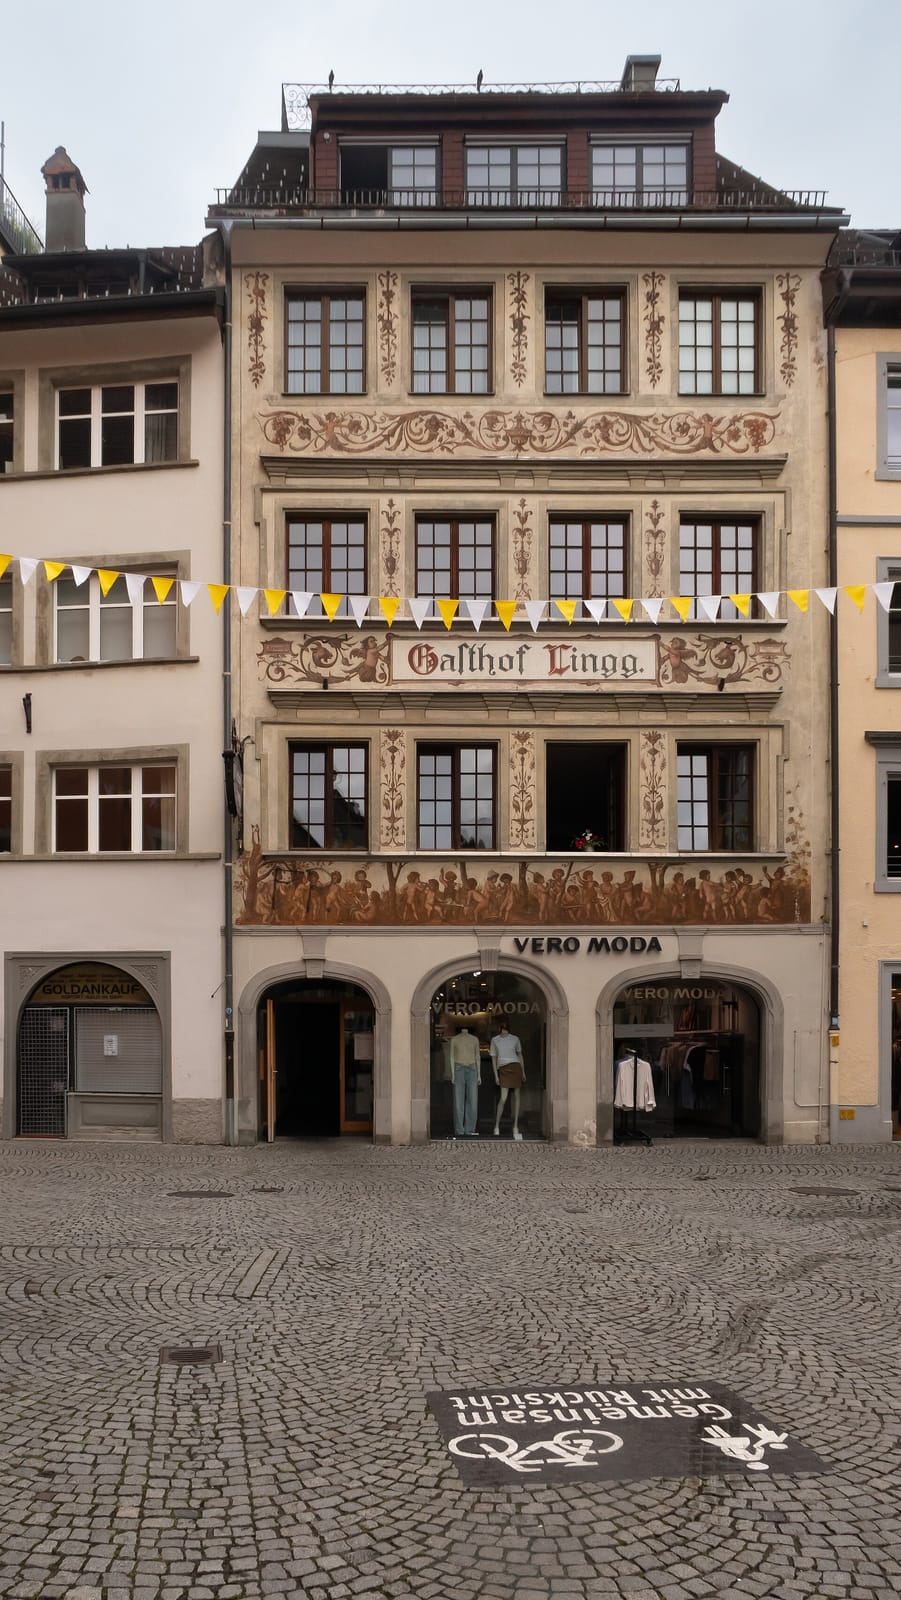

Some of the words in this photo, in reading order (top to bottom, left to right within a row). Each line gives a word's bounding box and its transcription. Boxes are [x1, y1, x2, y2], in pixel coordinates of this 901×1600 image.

[513, 936, 581, 954] VERO
[587, 936, 662, 954] MODA
[42, 984, 142, 995] GOLDANKAUF
[623, 987, 669, 1001] VERO
[673, 987, 725, 1001] MODA
[431, 1001, 482, 1015] VERO
[487, 1001, 540, 1015] MODA
[449, 1390, 638, 1410] Rücksicht
[640, 1387, 711, 1404] mit
[457, 1403, 732, 1427] Gemeinsam
